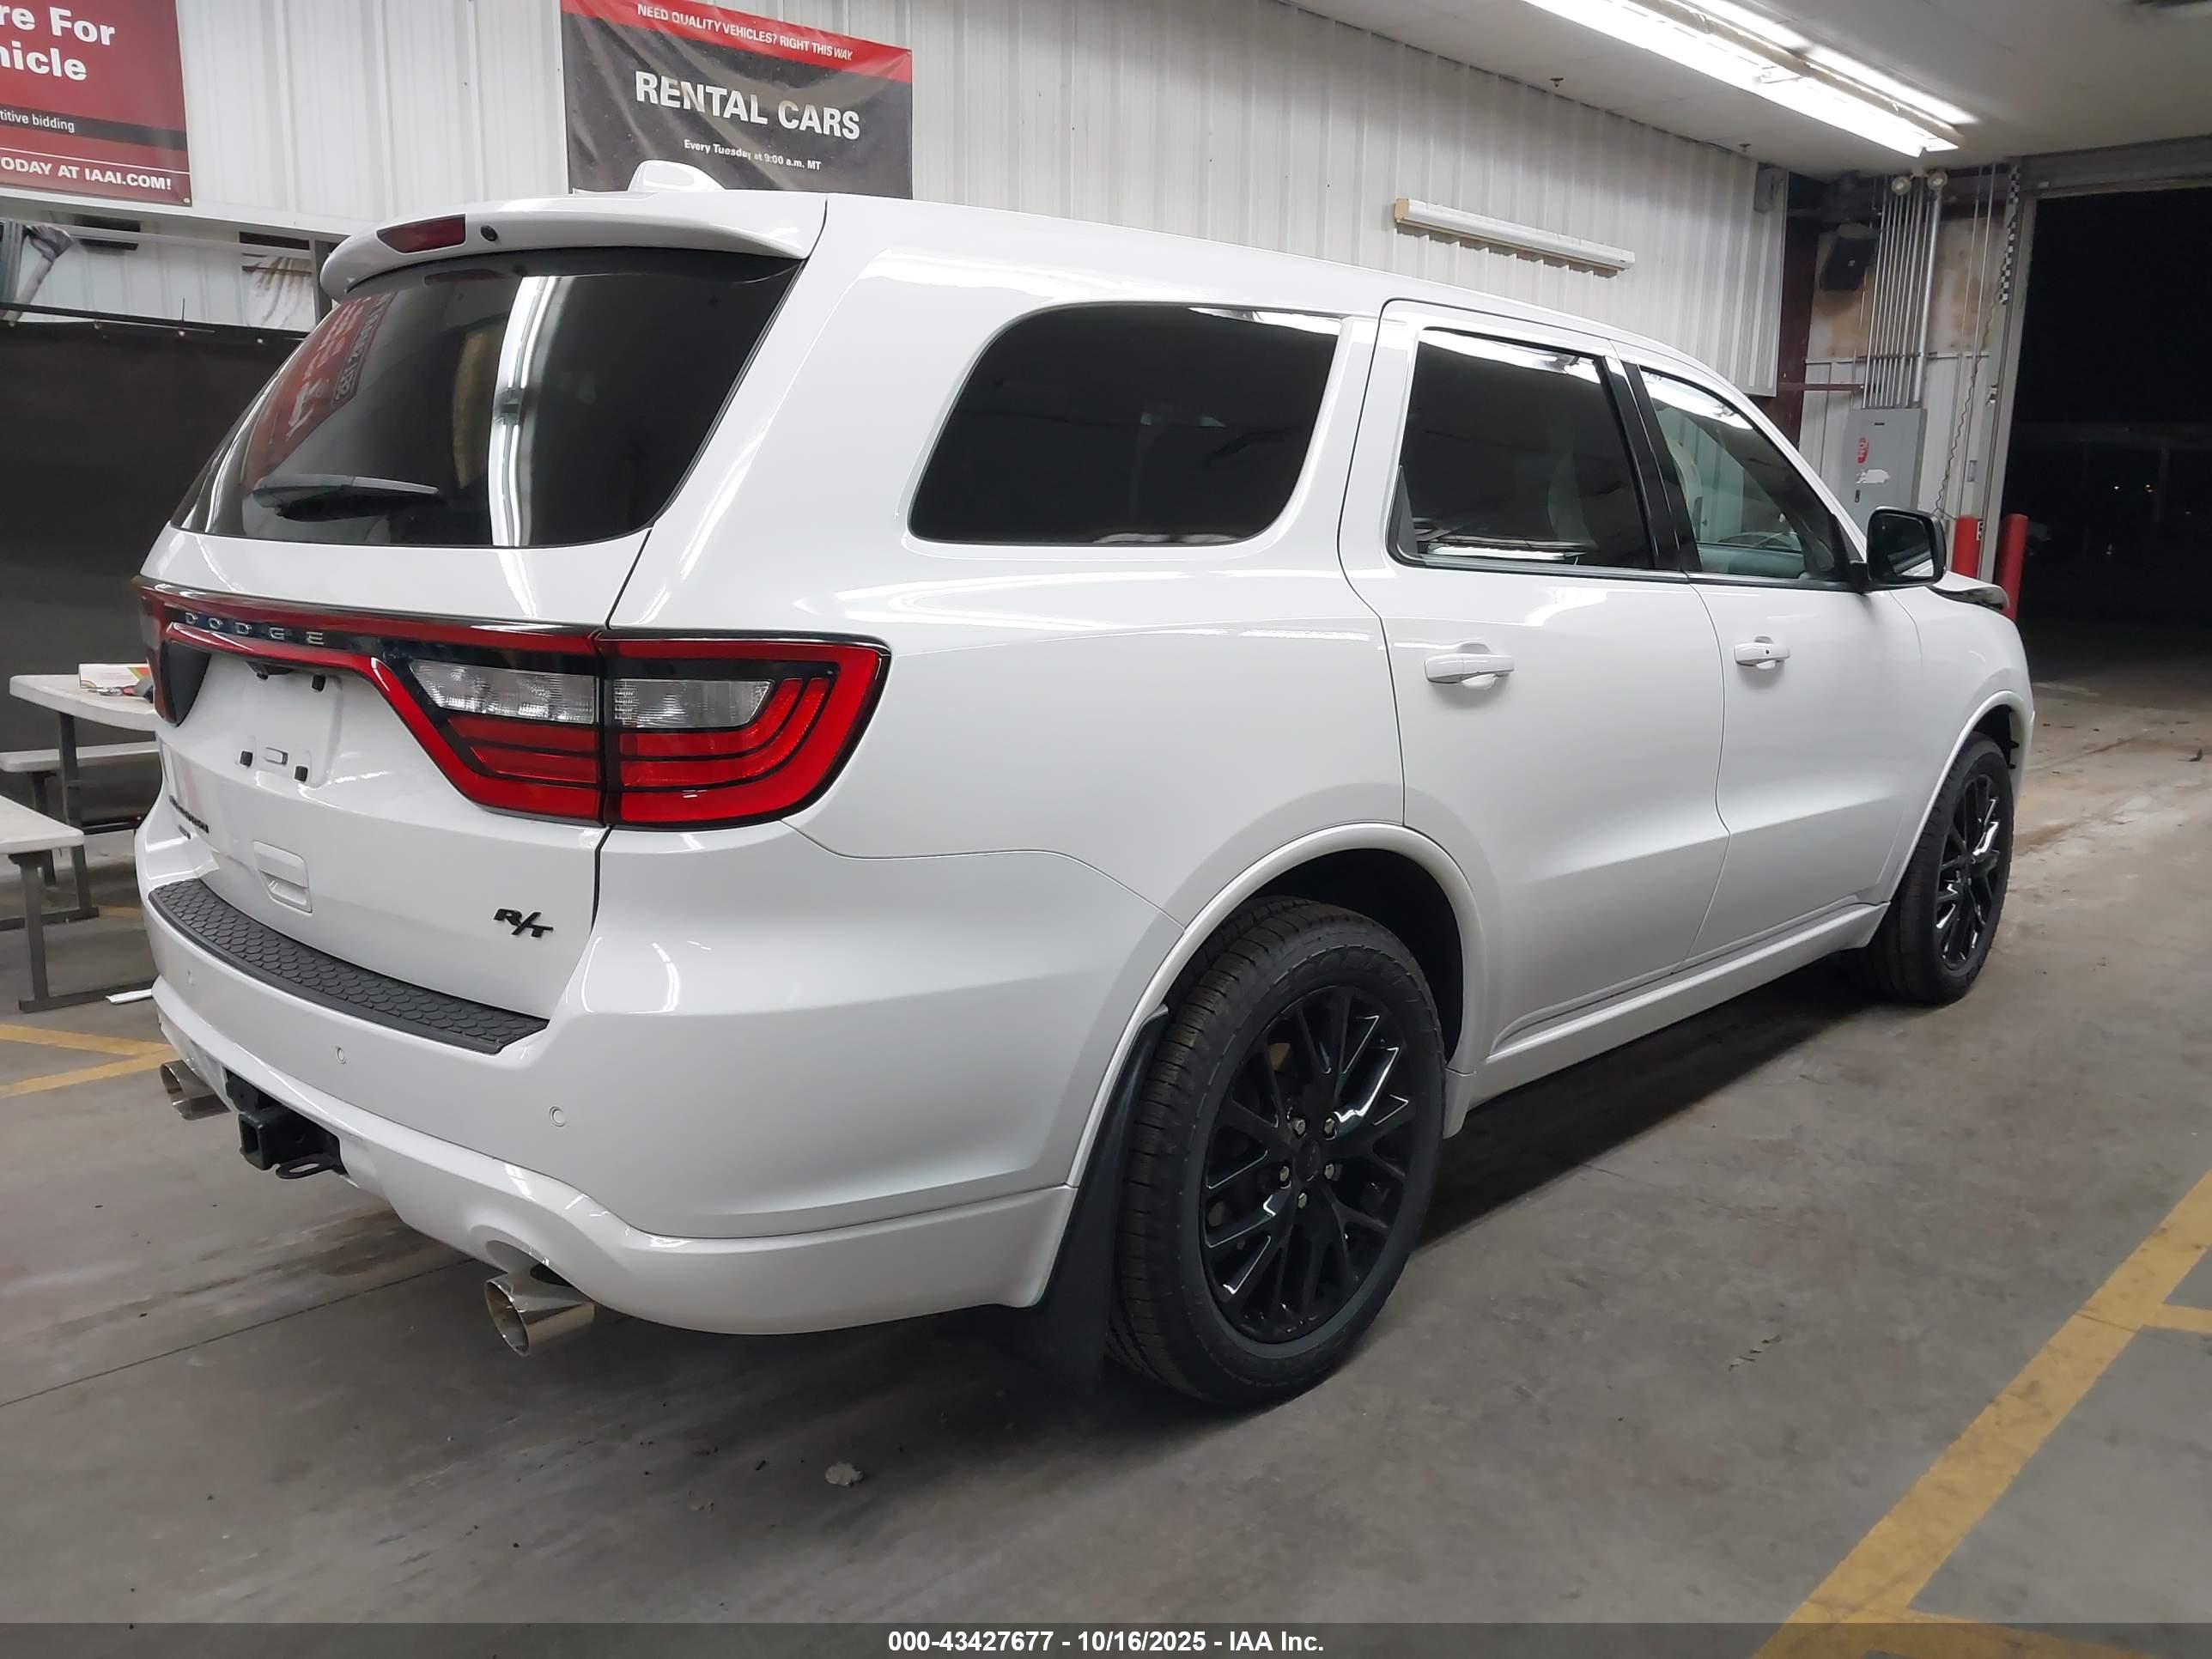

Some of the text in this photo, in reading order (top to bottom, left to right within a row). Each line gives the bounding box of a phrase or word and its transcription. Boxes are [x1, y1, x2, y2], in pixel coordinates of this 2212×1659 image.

[49, 6, 116, 46] For
[637, 3, 853, 61] NEED QUALITY VEHICLES? RIGHT THIS WAY.
[635, 70, 860, 140] RENTAL CARS
[32, 113, 76, 133] bidding
[684, 139, 822, 171] Every Tuesday at 9:00 a.m. MT
[0, 156, 172, 191] ODAY AT IAAI.COM!
[185, 611, 325, 646] DODGE
[493, 908, 554, 939] R/T
